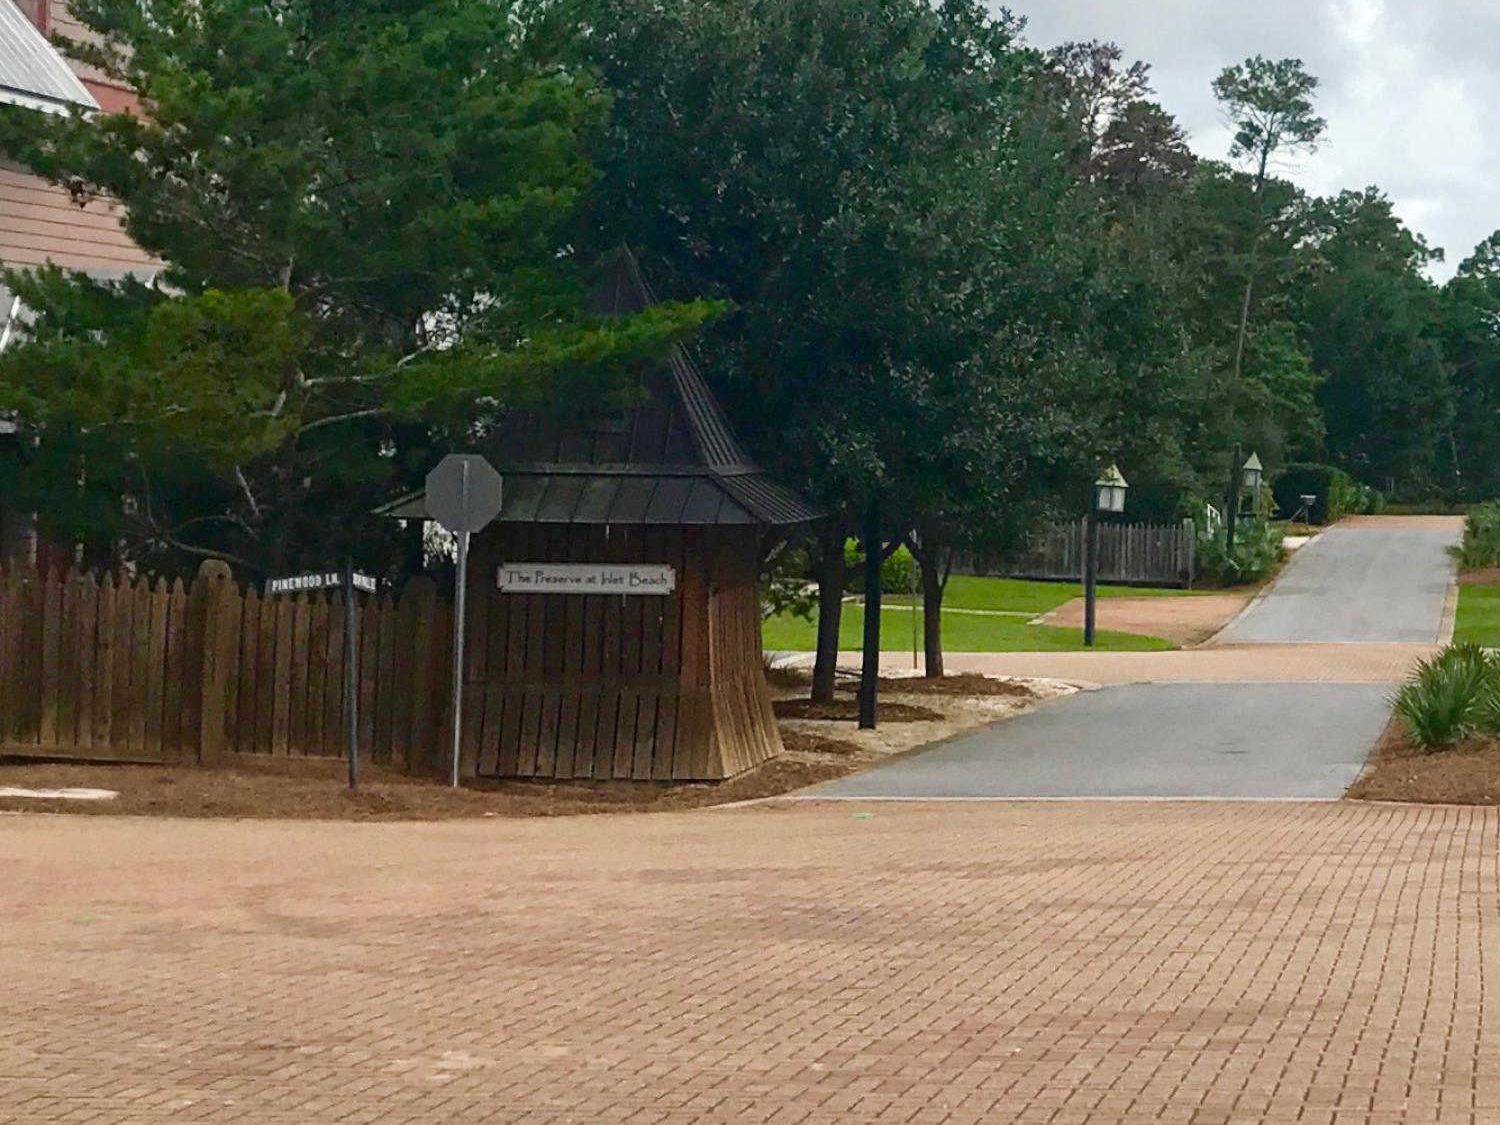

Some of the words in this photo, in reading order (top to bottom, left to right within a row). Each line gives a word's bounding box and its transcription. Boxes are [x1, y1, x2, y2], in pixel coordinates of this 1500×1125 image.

[272, 575, 322, 591] PINEWOOD
[506, 570, 530, 584] The
[535, 571, 582, 585] Preserve
[585, 575, 597, 584] at
[601, 571, 624, 585] Inlet
[629, 572, 668, 587] Beach
